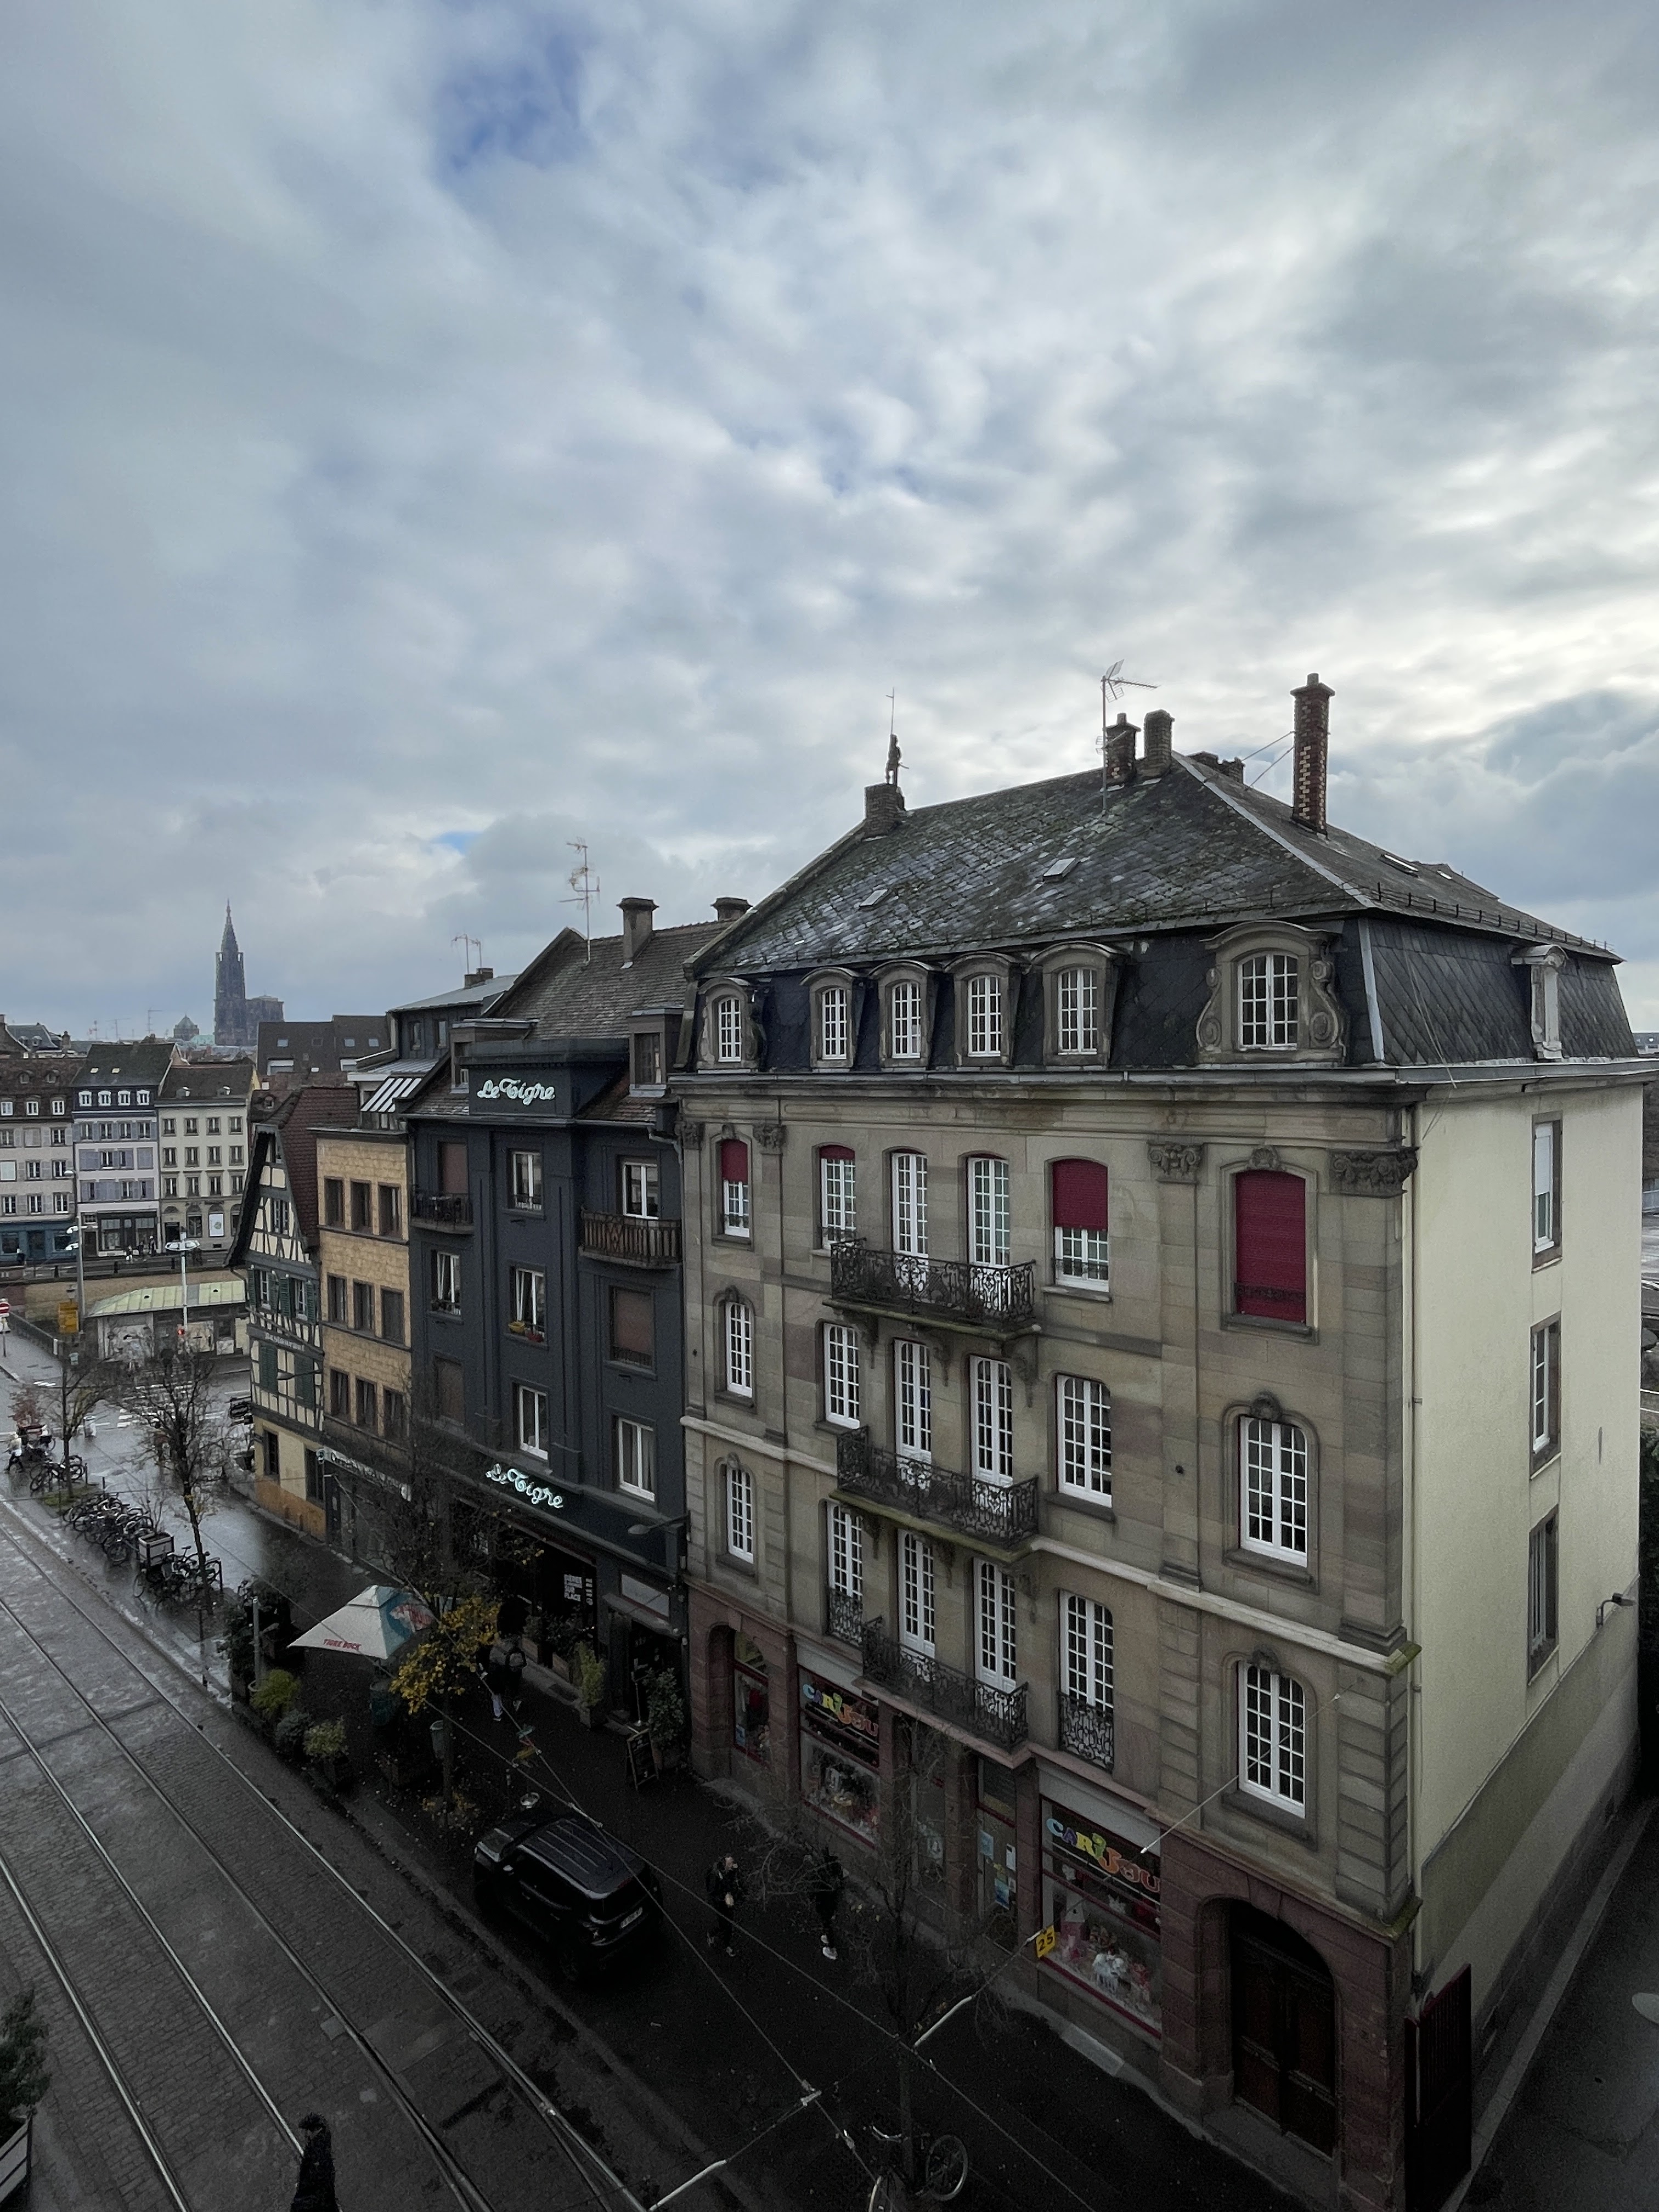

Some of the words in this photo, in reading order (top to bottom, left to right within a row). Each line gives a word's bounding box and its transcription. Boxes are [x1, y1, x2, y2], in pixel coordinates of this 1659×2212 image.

[477, 1080, 500, 1098] Le
[499, 1078, 555, 1105] Tigre
[486, 1463, 509, 1485] Le
[507, 1468, 564, 1509] Tigre
[1038, 1932, 1053, 1952] 25
